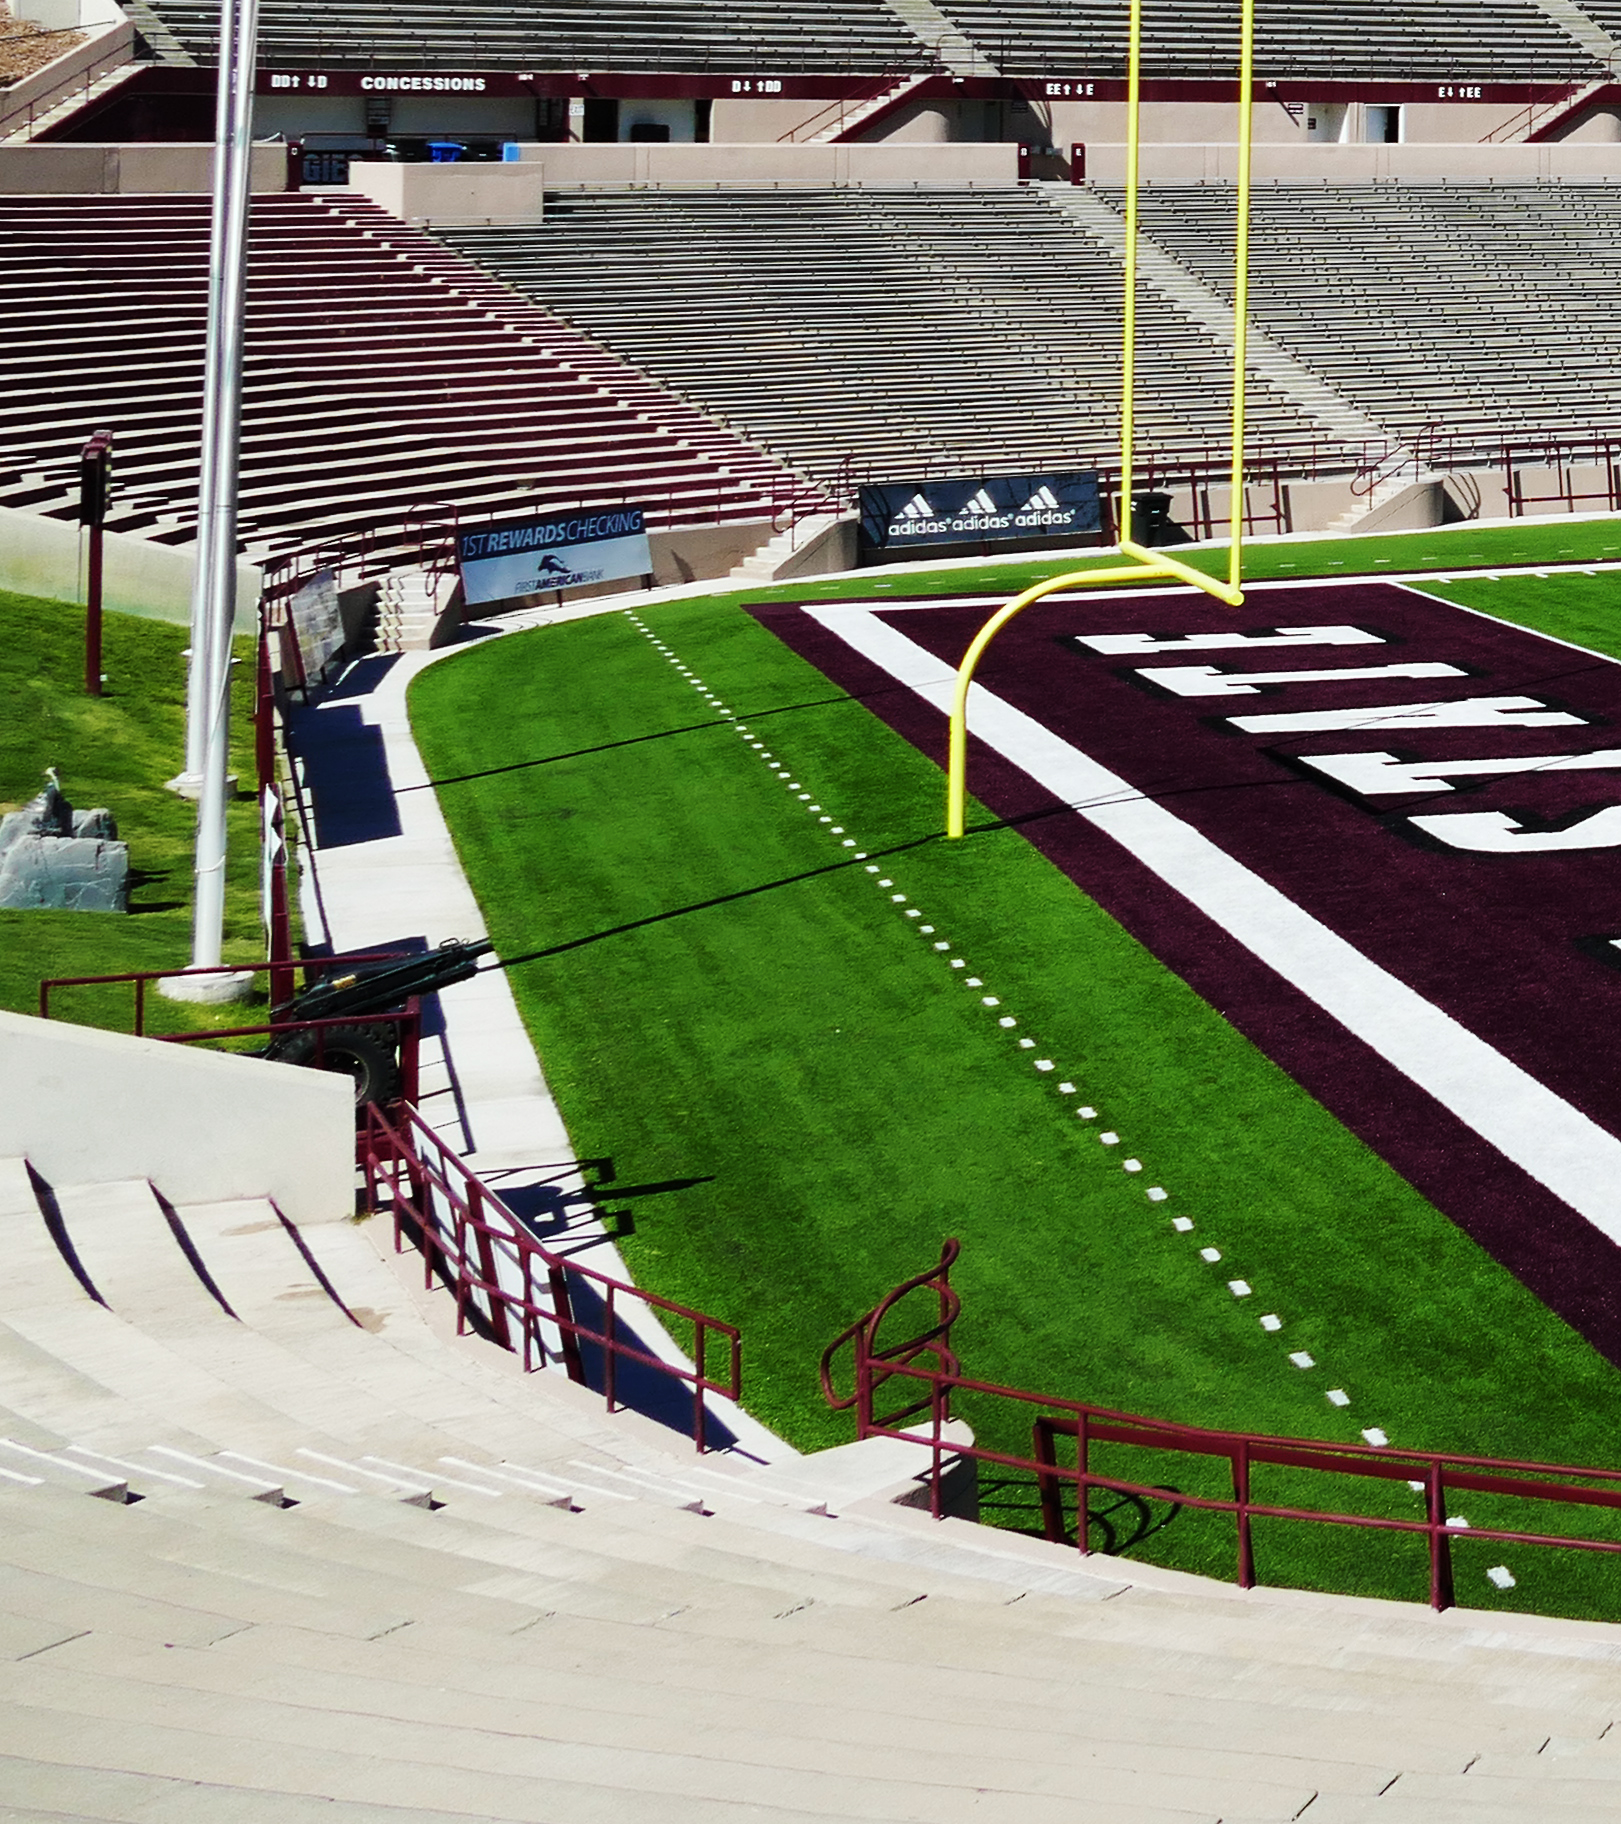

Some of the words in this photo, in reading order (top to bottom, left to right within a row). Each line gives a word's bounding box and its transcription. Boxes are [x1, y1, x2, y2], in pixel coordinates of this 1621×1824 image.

[271, 74, 290, 88] DD
[360, 76, 486, 91] CONCESSIONS
[1046, 83, 1061, 95] EE
[1086, 84, 1094, 95] E
[1439, 87, 1445, 97] E
[1467, 87, 1481, 98] EE
